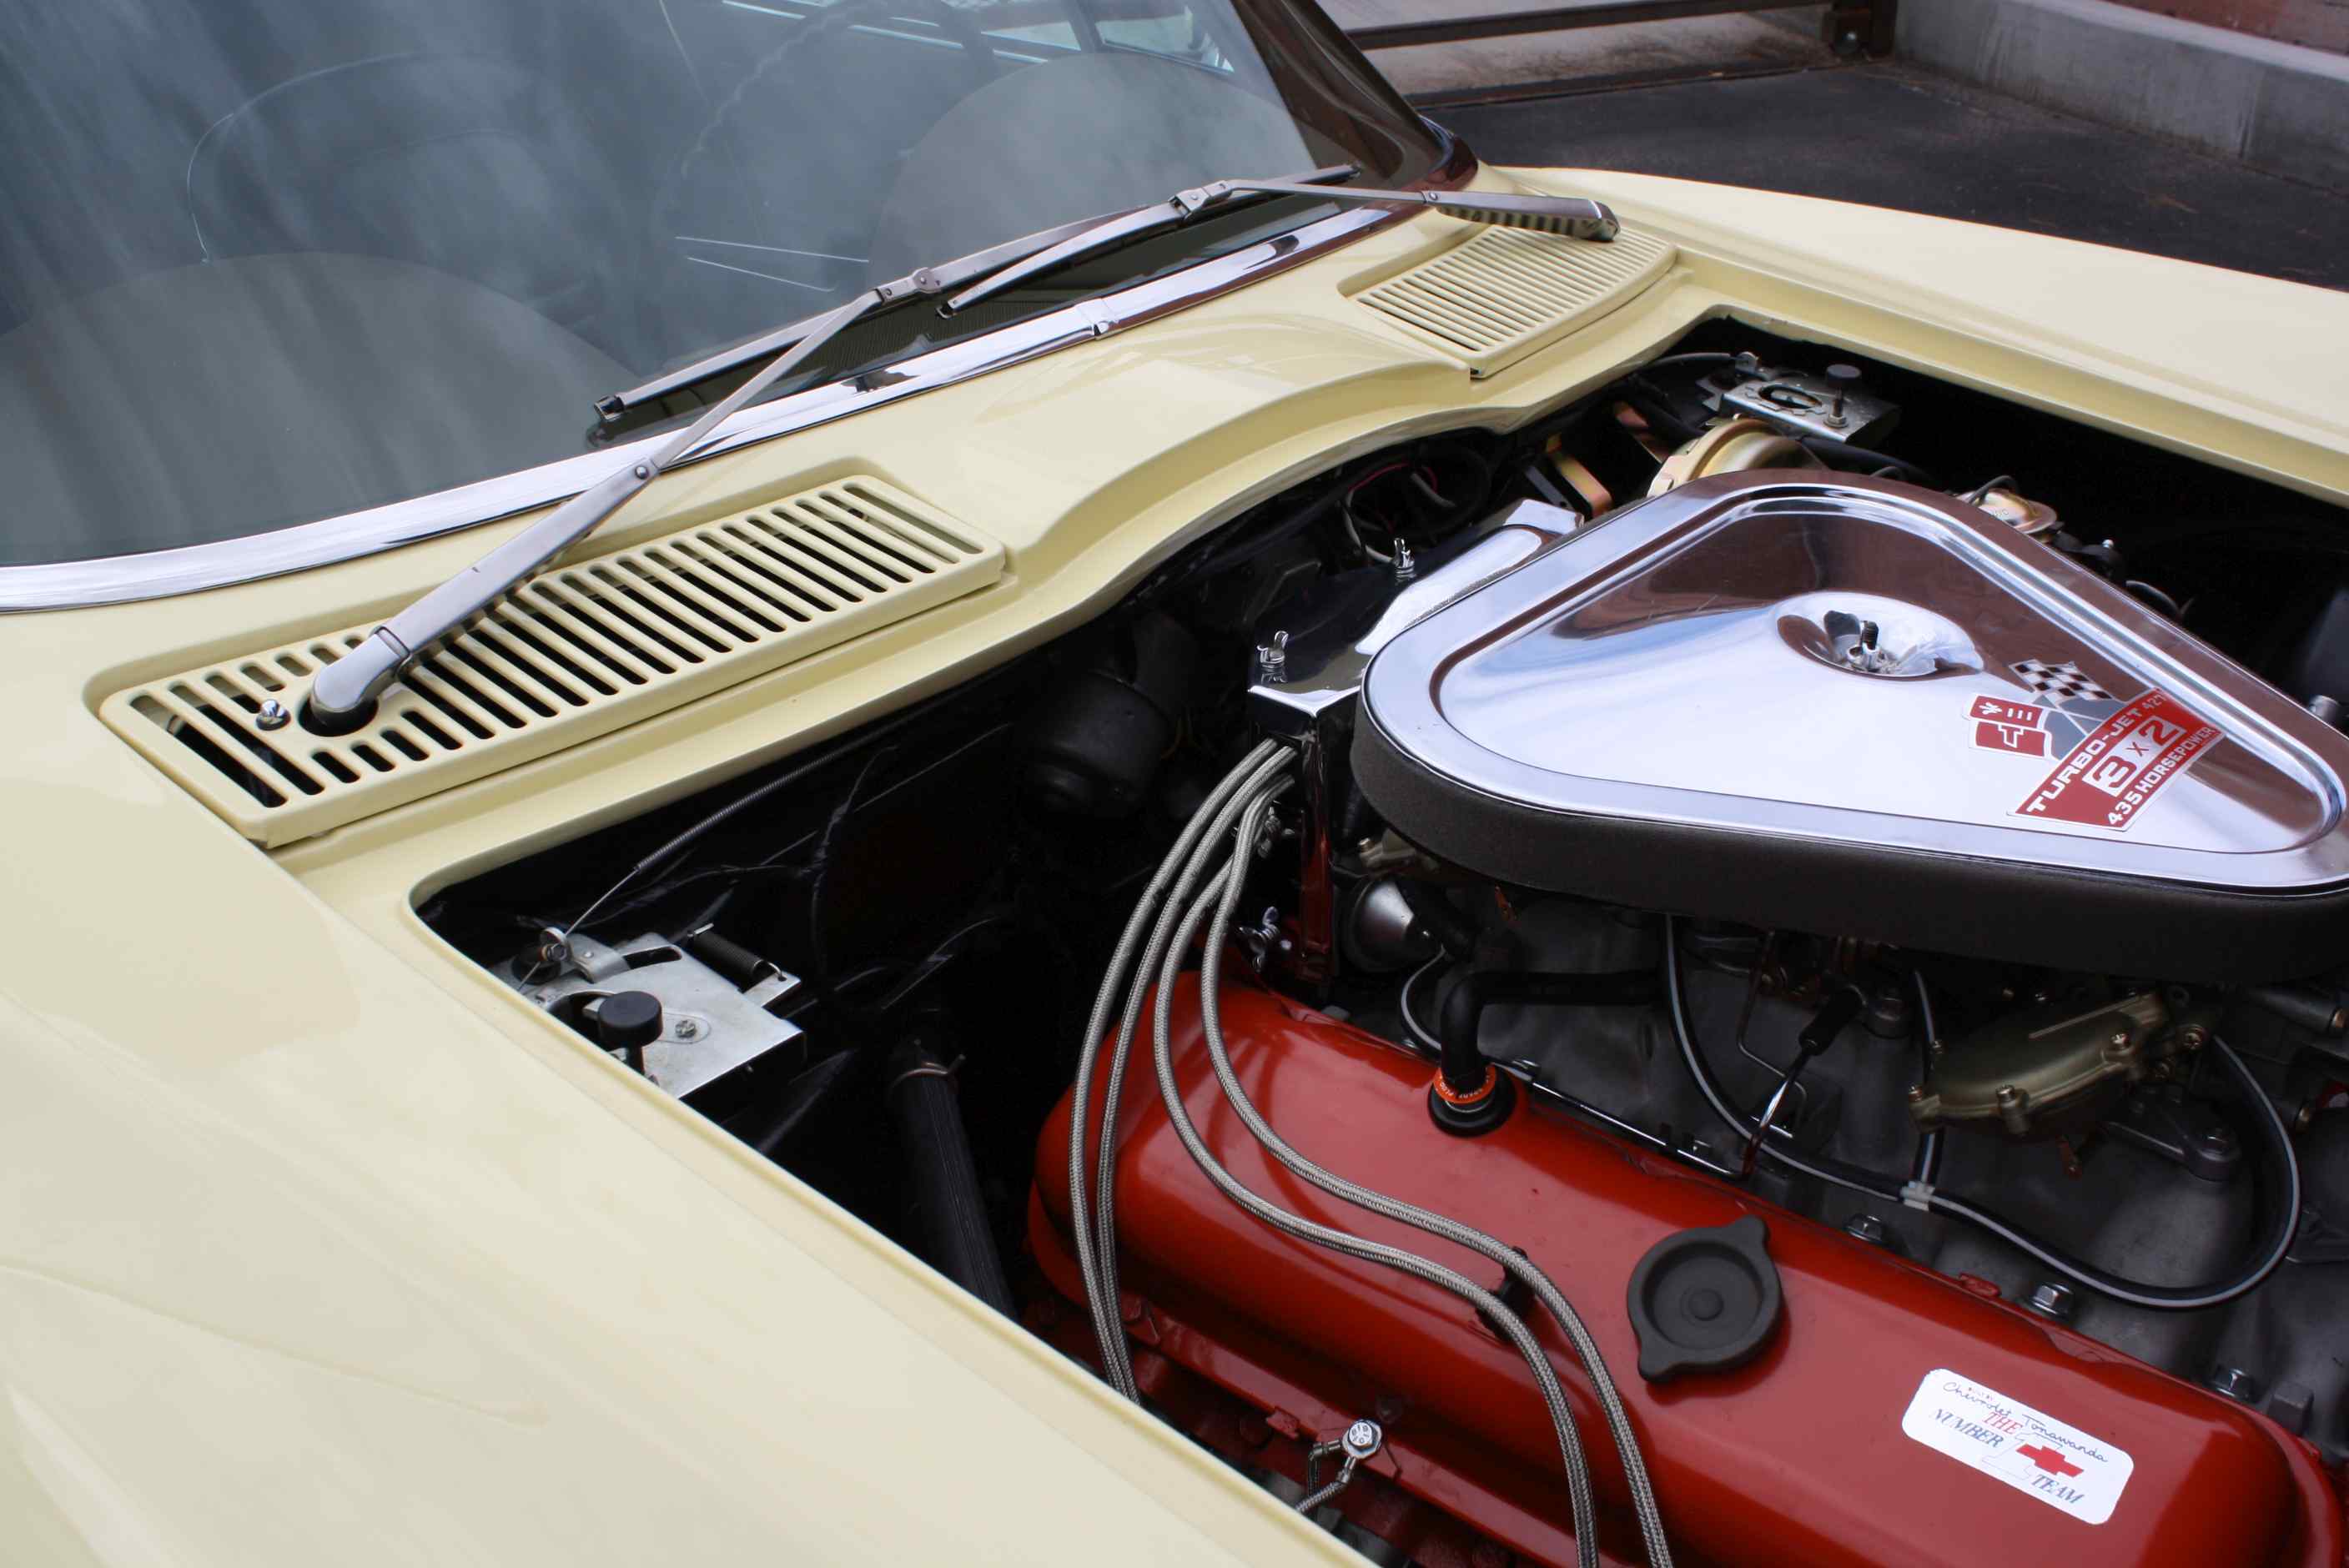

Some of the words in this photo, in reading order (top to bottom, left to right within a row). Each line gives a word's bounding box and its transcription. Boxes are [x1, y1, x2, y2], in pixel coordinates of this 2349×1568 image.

[2026, 708, 2143, 813] TURBO-JET
[2141, 694, 2167, 711] 427
[2092, 755, 2137, 788] 3
[2138, 719, 2179, 746] 2
[2107, 789, 2142, 825] 435
[2136, 726, 2216, 793] HORSEPOWER
[1933, 1409, 2004, 1448] NUMBER
[1983, 1411, 2023, 1435] THE
[2022, 1414, 2109, 1463] Tonawanda
[2031, 1474, 2085, 1504] TEAM
